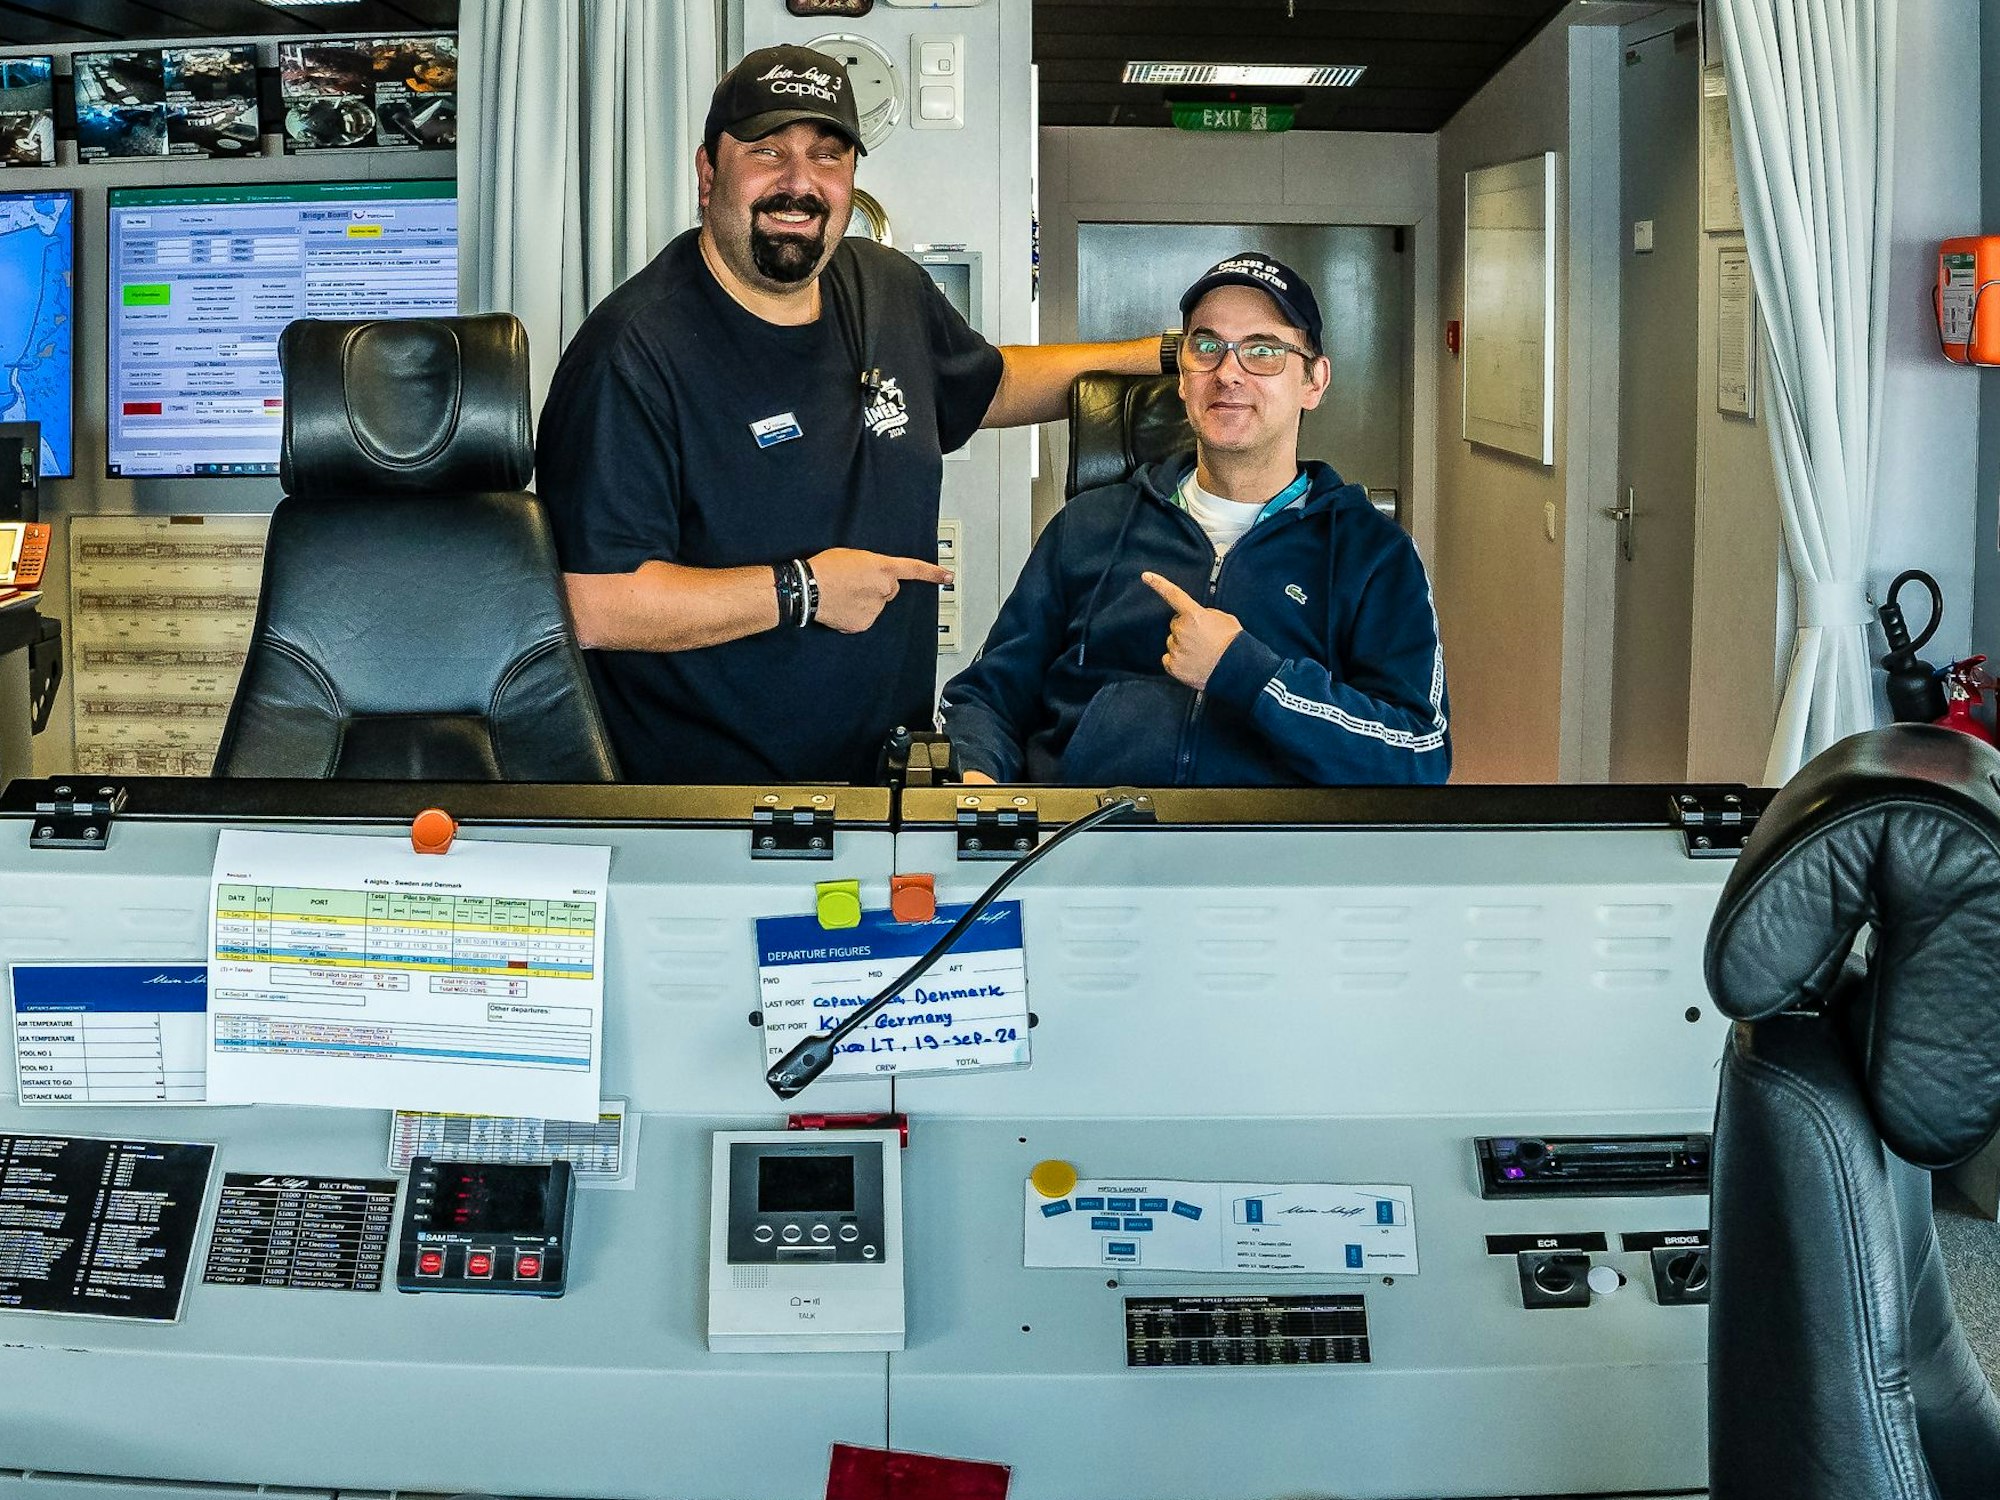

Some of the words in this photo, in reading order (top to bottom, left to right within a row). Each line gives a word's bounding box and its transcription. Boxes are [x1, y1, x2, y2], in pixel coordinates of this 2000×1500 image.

[757, 65, 794, 81] Mein
[793, 66, 830, 86] Schiff
[832, 77, 842, 91] 3
[771, 81, 837, 103] Captain
[1203, 108, 1241, 127] EXIT
[369, 878, 390, 886] nights
[434, 881, 462, 889] Denmark
[495, 899, 527, 907] Departure
[767, 949, 828, 962] DEPARTURE
[828, 945, 871, 959] FIGURES
[309, 970, 325, 978] Total
[325, 972, 341, 980] pilot
[763, 976, 780, 985] FWD
[868, 970, 883, 978] MID
[949, 964, 963, 973] AFT
[915, 984, 1005, 1005] Denmark
[764, 1000, 784, 1009] LAST
[784, 998, 806, 1008] PORT
[489, 1004, 509, 1013] Other
[510, 1006, 551, 1015] departures:
[875, 1012, 952, 1029] Germany
[766, 1023, 787, 1032] NEXT
[787, 1021, 808, 1031] PORT
[769, 1047, 784, 1055] ETA
[875, 1063, 897, 1072] CREW
[956, 1057, 980, 1067] TOTAL
[220, 1208, 239, 1216] Safety
[425, 1233, 447, 1242] SAM
[1664, 1235, 1700, 1246] BRIDGE
[1537, 1238, 1558, 1249] ECR
[797, 1311, 817, 1320] TALK
